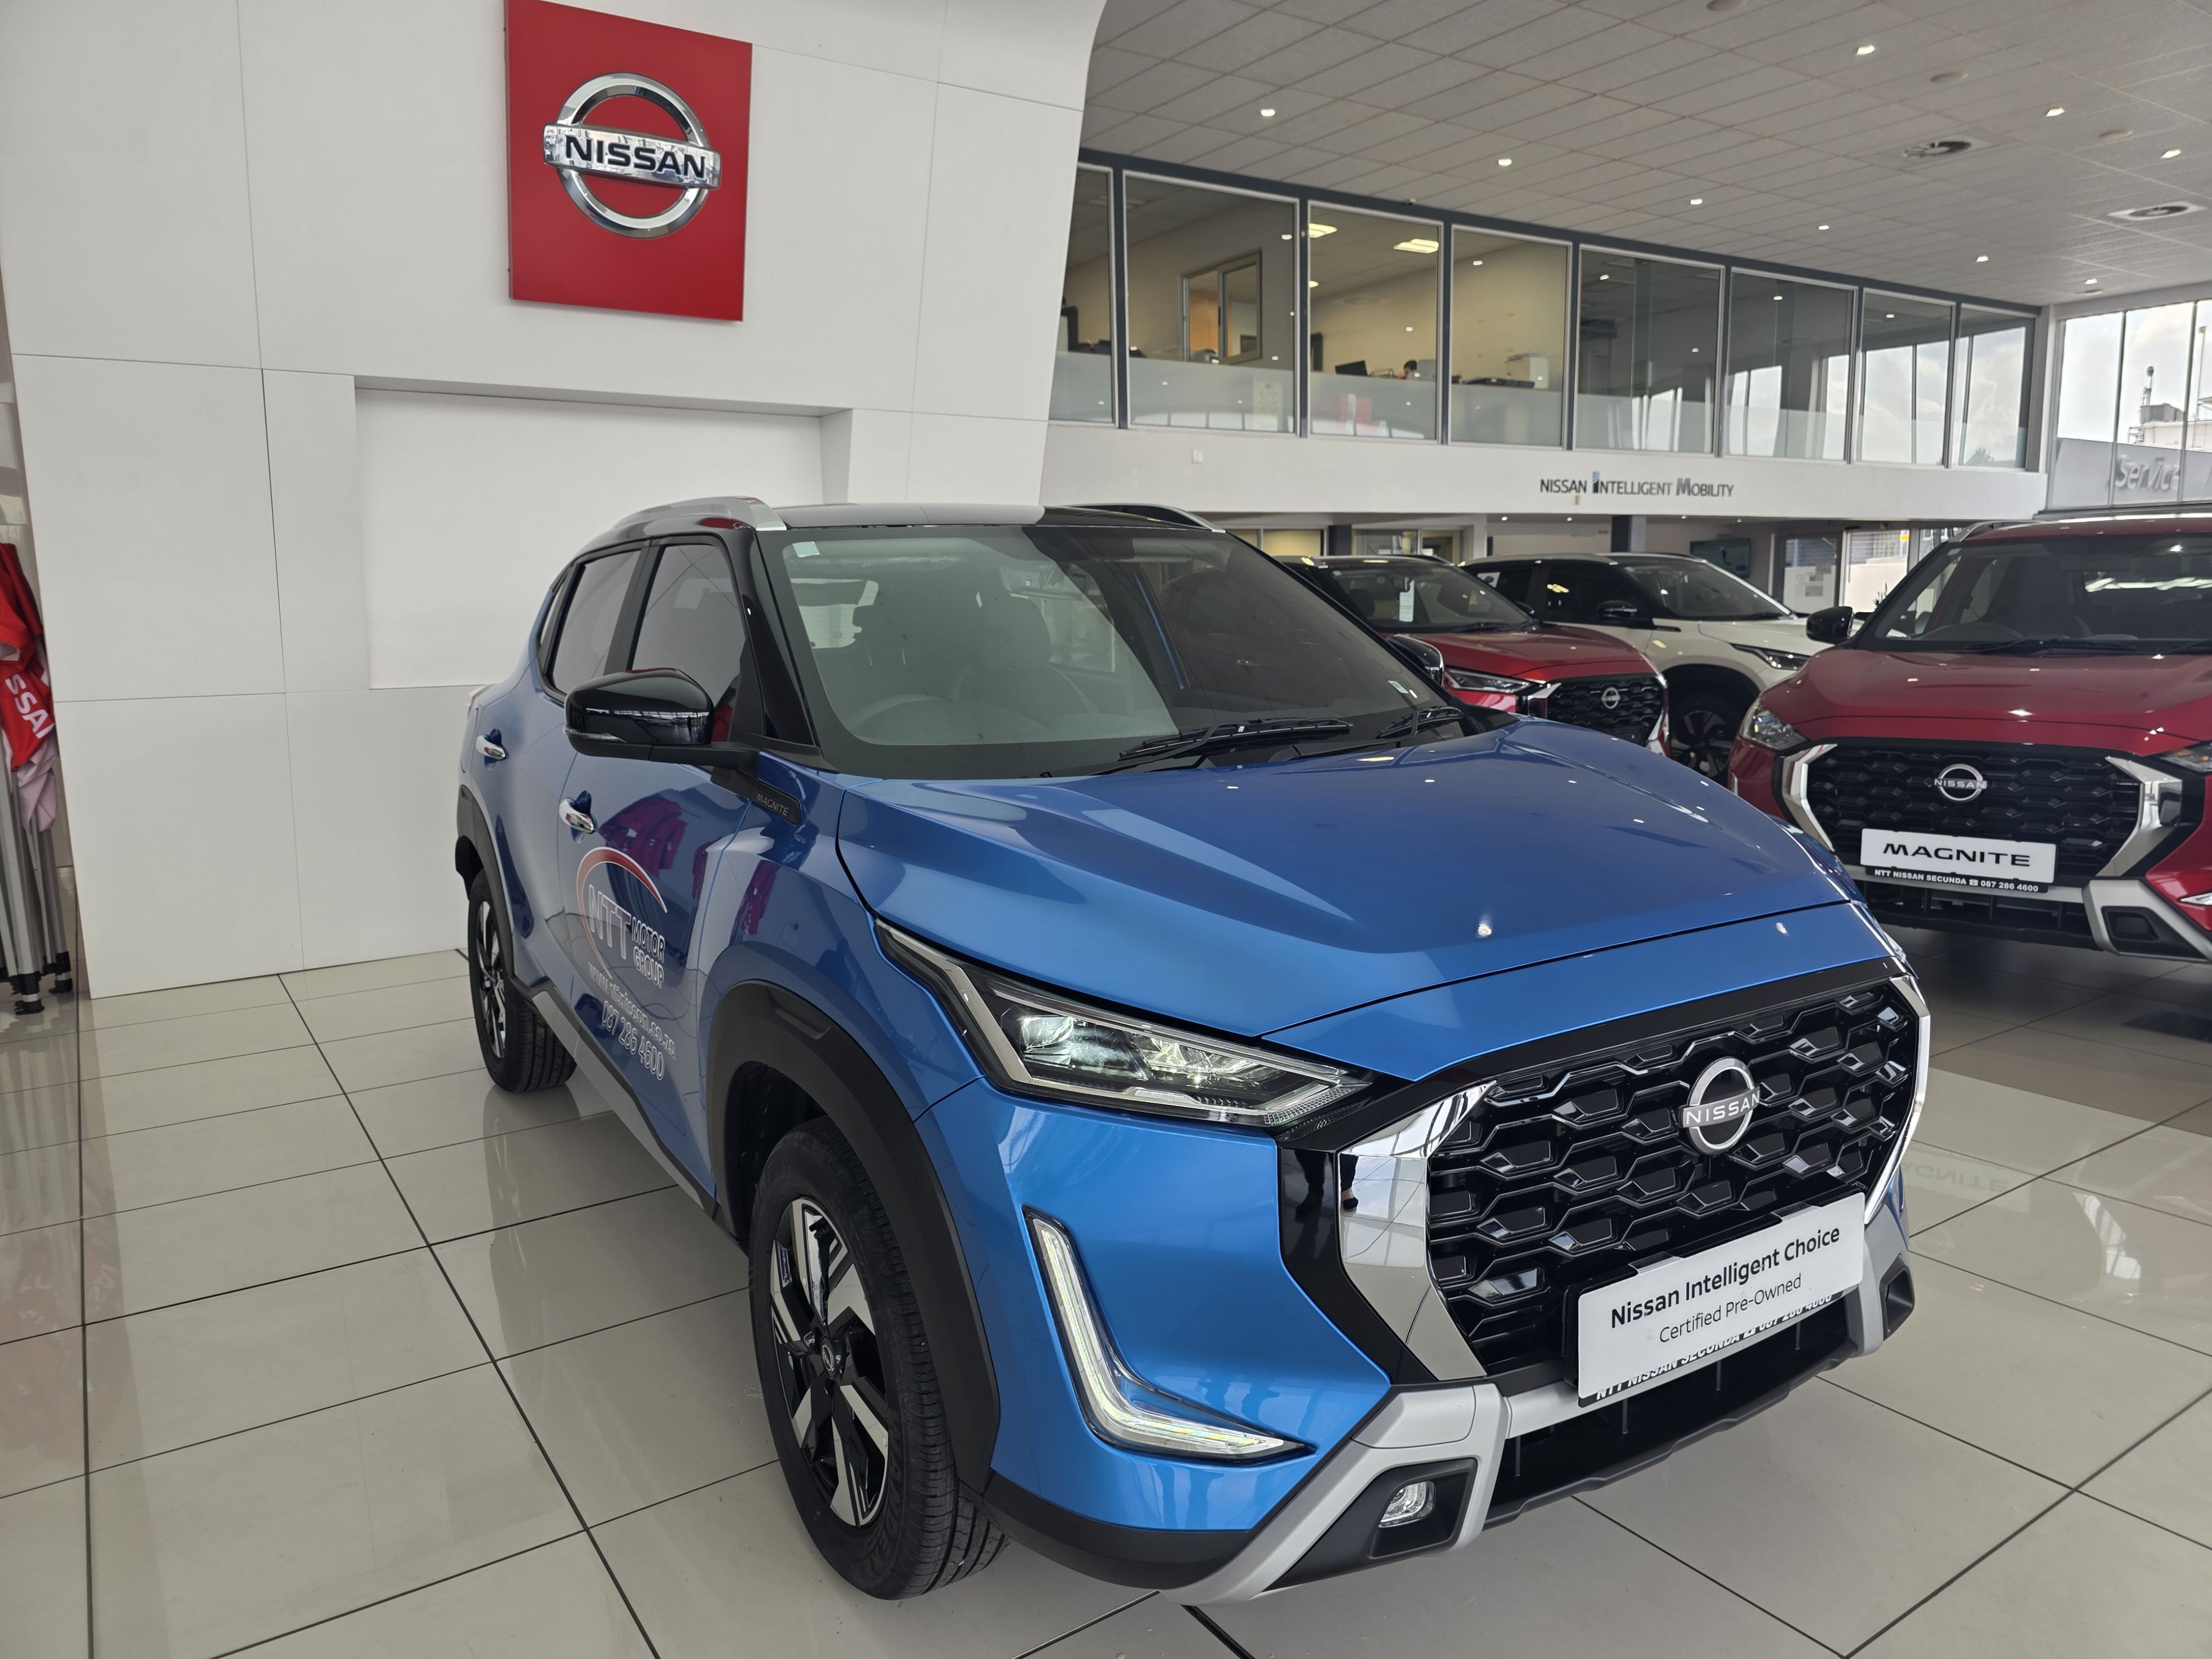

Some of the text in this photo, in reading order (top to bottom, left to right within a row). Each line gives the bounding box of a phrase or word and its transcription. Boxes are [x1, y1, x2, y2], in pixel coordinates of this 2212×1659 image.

[565, 135, 706, 178] NISSAN
[1540, 471, 1734, 497] NISSAN INTELLIGENT MOBILITY
[756, 793, 789, 817] MAGNITE
[1934, 778, 1987, 789] NISSAN
[1883, 843, 2030, 867] MAGNITE
[1893, 871, 1924, 881] NISSAN
[1926, 875, 1967, 885] SECUNDA
[1999, 881, 2015, 890] 286
[2017, 884, 2039, 892] 4600
[589, 884, 631, 960] NTT
[631, 916, 665, 963] MOTOR
[633, 946, 664, 989] GROUP
[602, 1000, 665, 1081] 087 286 4600
[1686, 1090, 1759, 1125] NISSAN
[1612, 1227, 1840, 1329] Nissan Intelligent Choice
[1660, 1305, 1721, 1343] Certified
[1726, 1273, 1801, 1318] Pre-Owned
